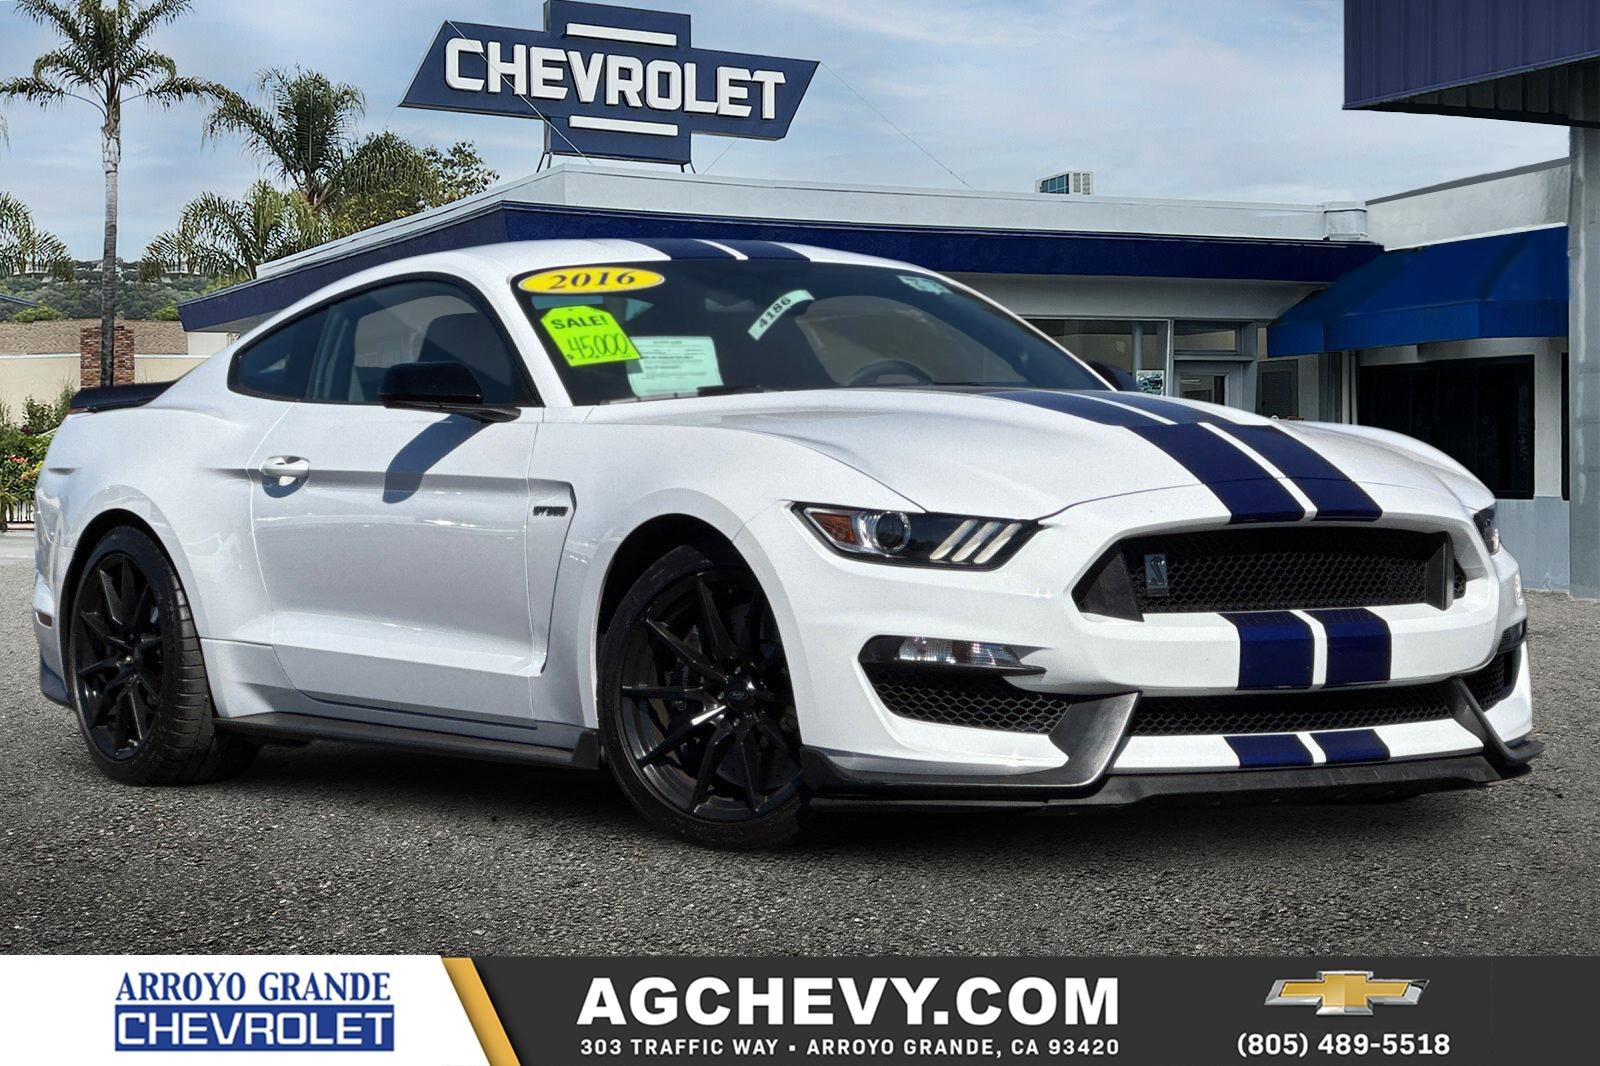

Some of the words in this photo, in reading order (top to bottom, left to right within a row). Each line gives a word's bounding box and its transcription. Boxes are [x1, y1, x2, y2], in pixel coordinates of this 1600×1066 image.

[445, 37, 787, 121] CHEVROLET
[548, 271, 636, 291] 2016
[551, 315, 609, 330] SALE!
[758, 296, 792, 330] 4186
